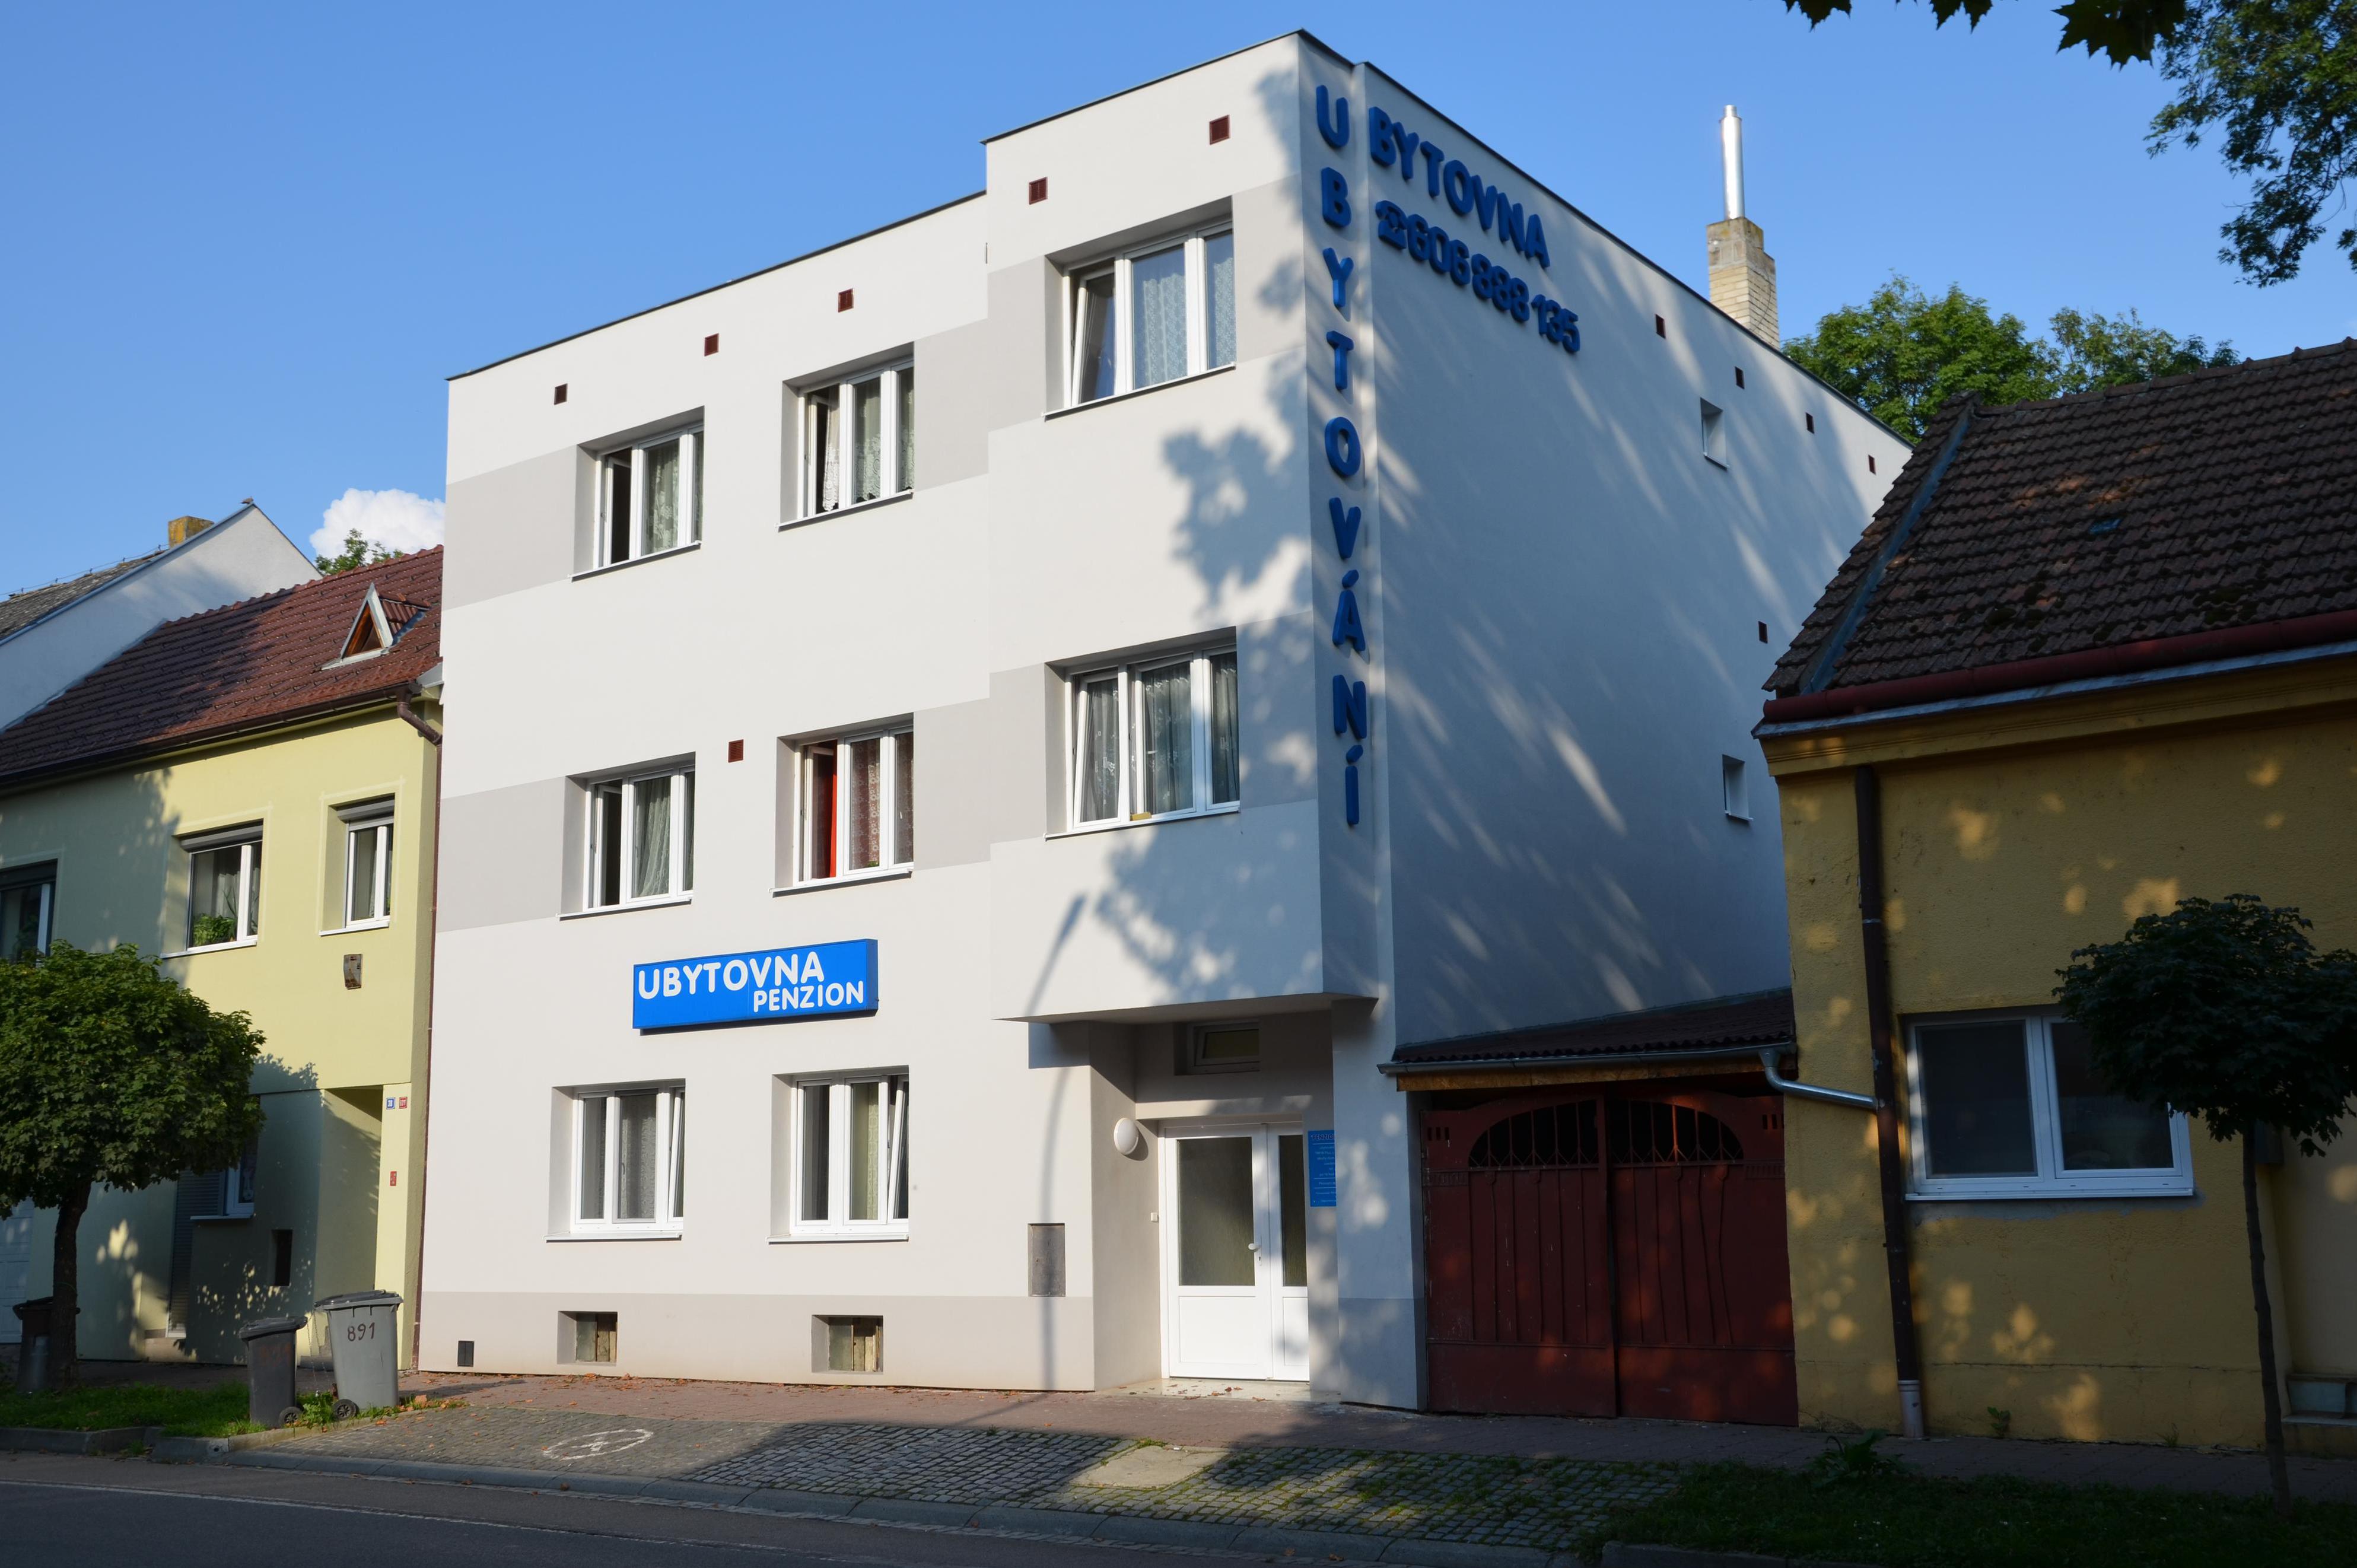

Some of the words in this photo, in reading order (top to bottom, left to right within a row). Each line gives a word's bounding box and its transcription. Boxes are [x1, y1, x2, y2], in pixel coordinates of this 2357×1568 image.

[1407, 213, 1471, 285] 606
[1471, 253, 1530, 322] 888
[1531, 294, 1580, 353] 135
[1316, 84, 1368, 825] UBYTOVÁNÍ
[638, 951, 825, 1000] UBYTOVNA
[753, 981, 864, 1013] PENZION
[347, 1322, 376, 1342] 891
